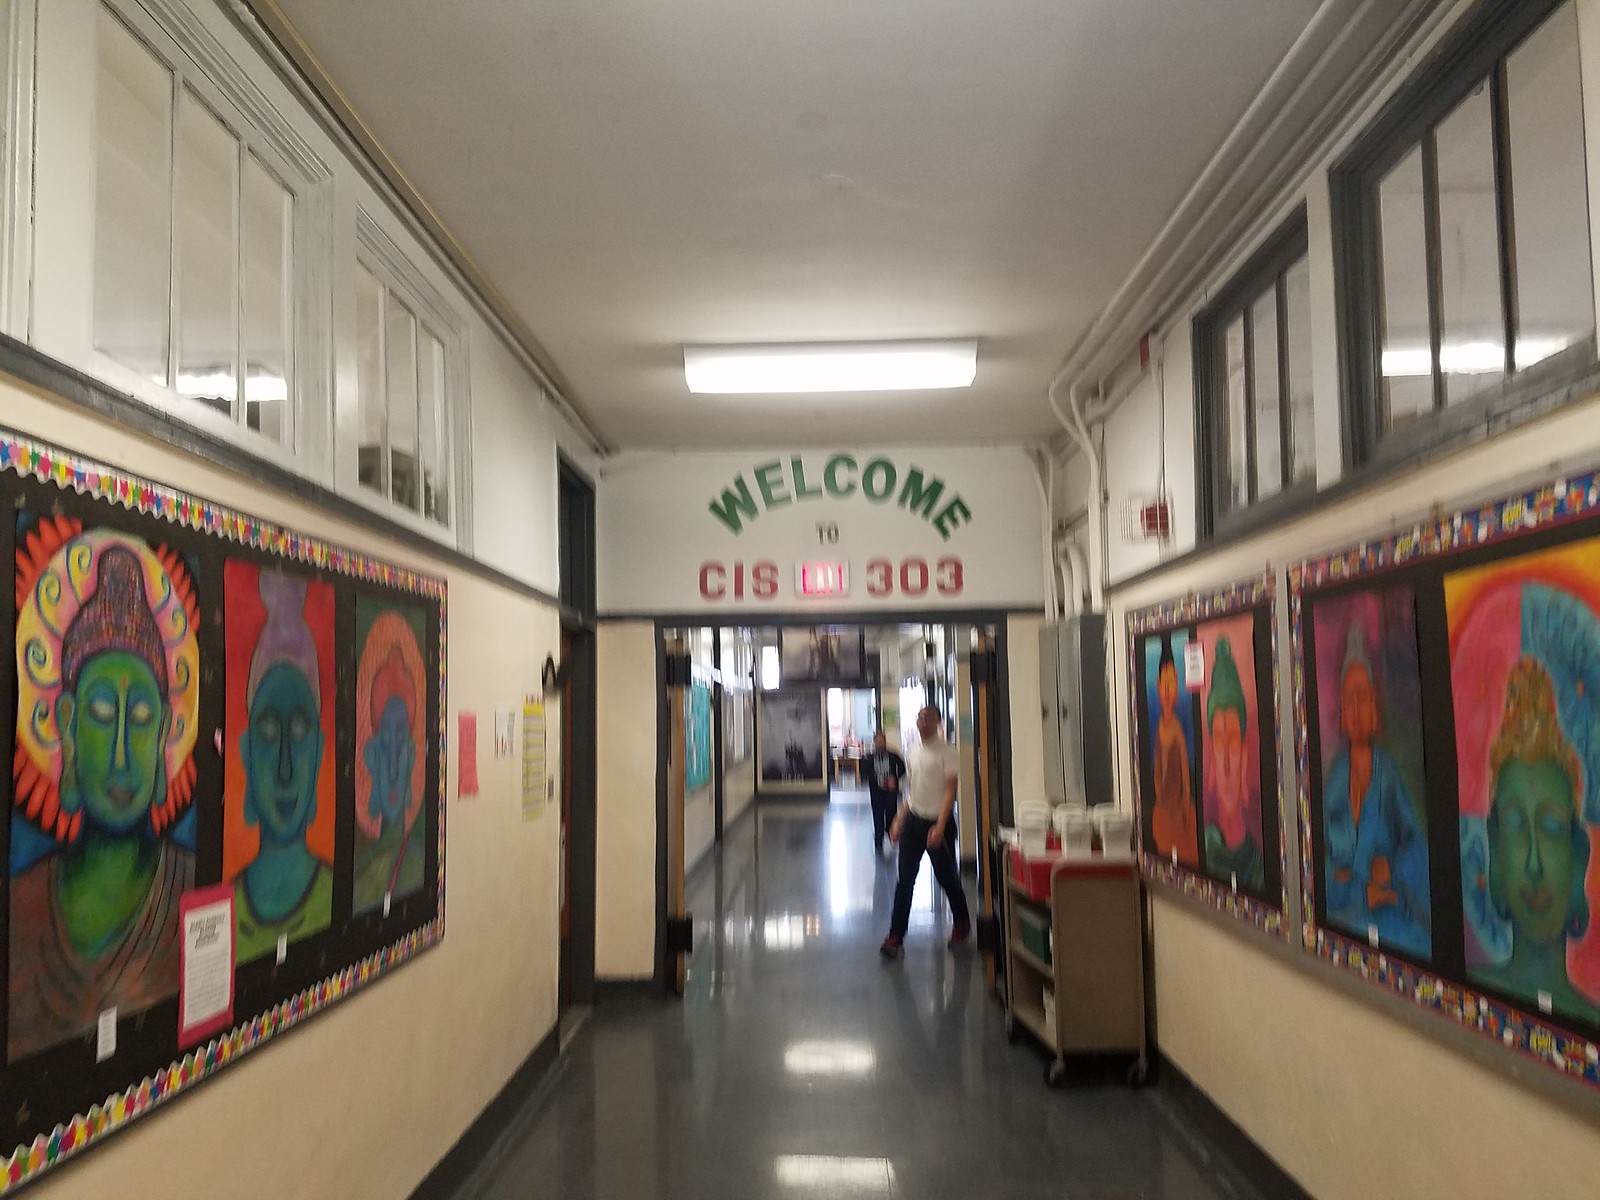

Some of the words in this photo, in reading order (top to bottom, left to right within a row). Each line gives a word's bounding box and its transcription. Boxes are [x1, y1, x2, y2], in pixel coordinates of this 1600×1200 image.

[709, 454, 972, 541] WELCOME
[815, 521, 840, 544] TO
[699, 559, 779, 601] CIS
[866, 556, 964, 600] 303
